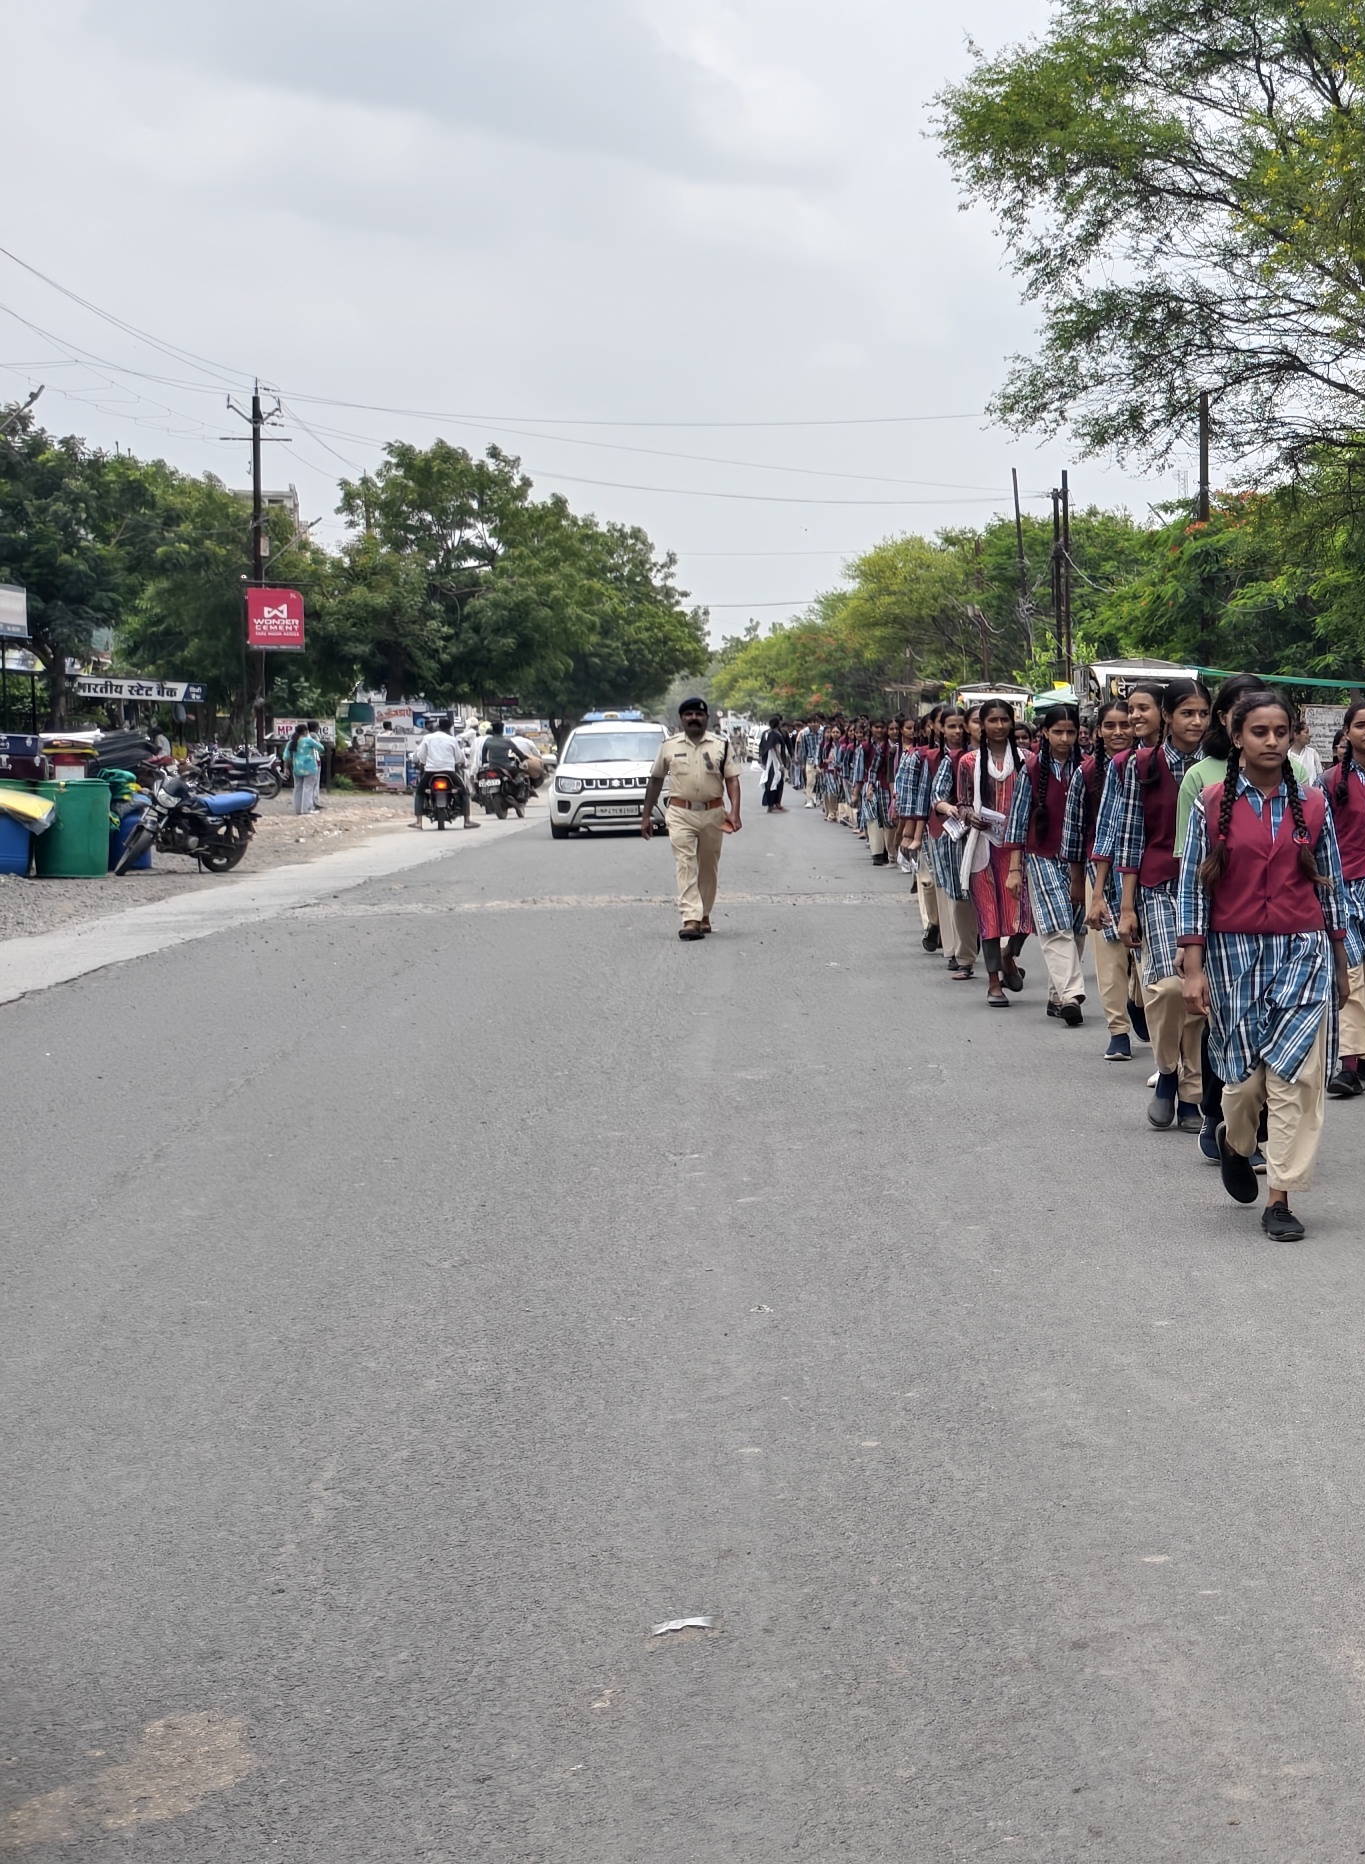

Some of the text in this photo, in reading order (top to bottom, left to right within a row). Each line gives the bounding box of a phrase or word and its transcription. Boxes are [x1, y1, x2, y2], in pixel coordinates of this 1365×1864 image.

[253, 618, 300, 626] WONDER
[127, 683, 153, 696] स्टेट
[156, 682, 178, 698] बैंक
